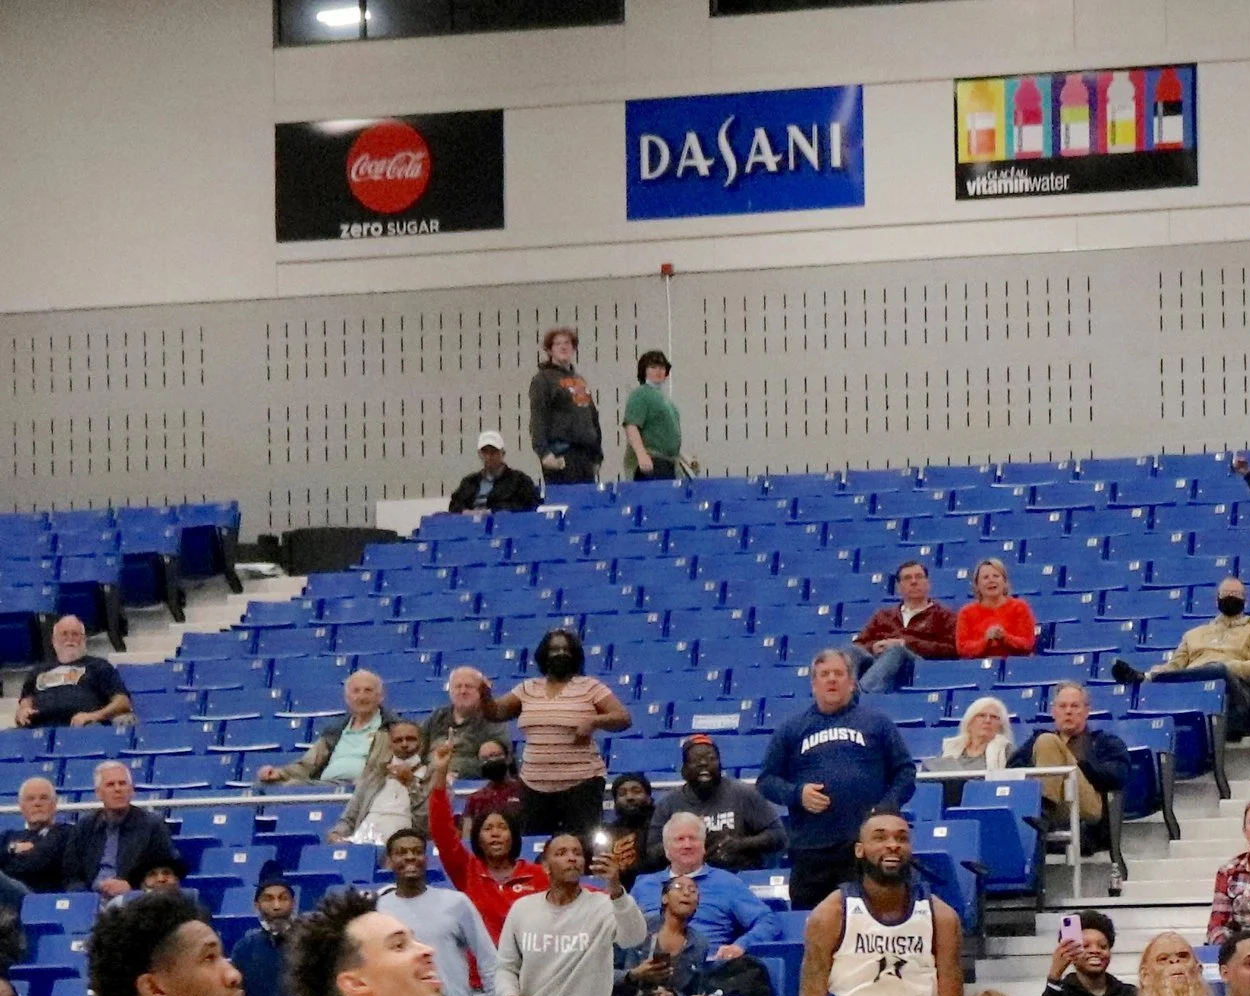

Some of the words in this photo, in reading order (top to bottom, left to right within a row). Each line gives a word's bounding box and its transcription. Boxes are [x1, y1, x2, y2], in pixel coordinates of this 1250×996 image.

[639, 113, 844, 188] DASANI
[351, 151, 428, 182] Coca-Cola
[966, 172, 1071, 197] vitaminwater
[339, 222, 384, 240] zero
[387, 218, 440, 236] SUGAR
[800, 727, 867, 755] AUGUSTA
[854, 933, 924, 955] AUGUSTA
